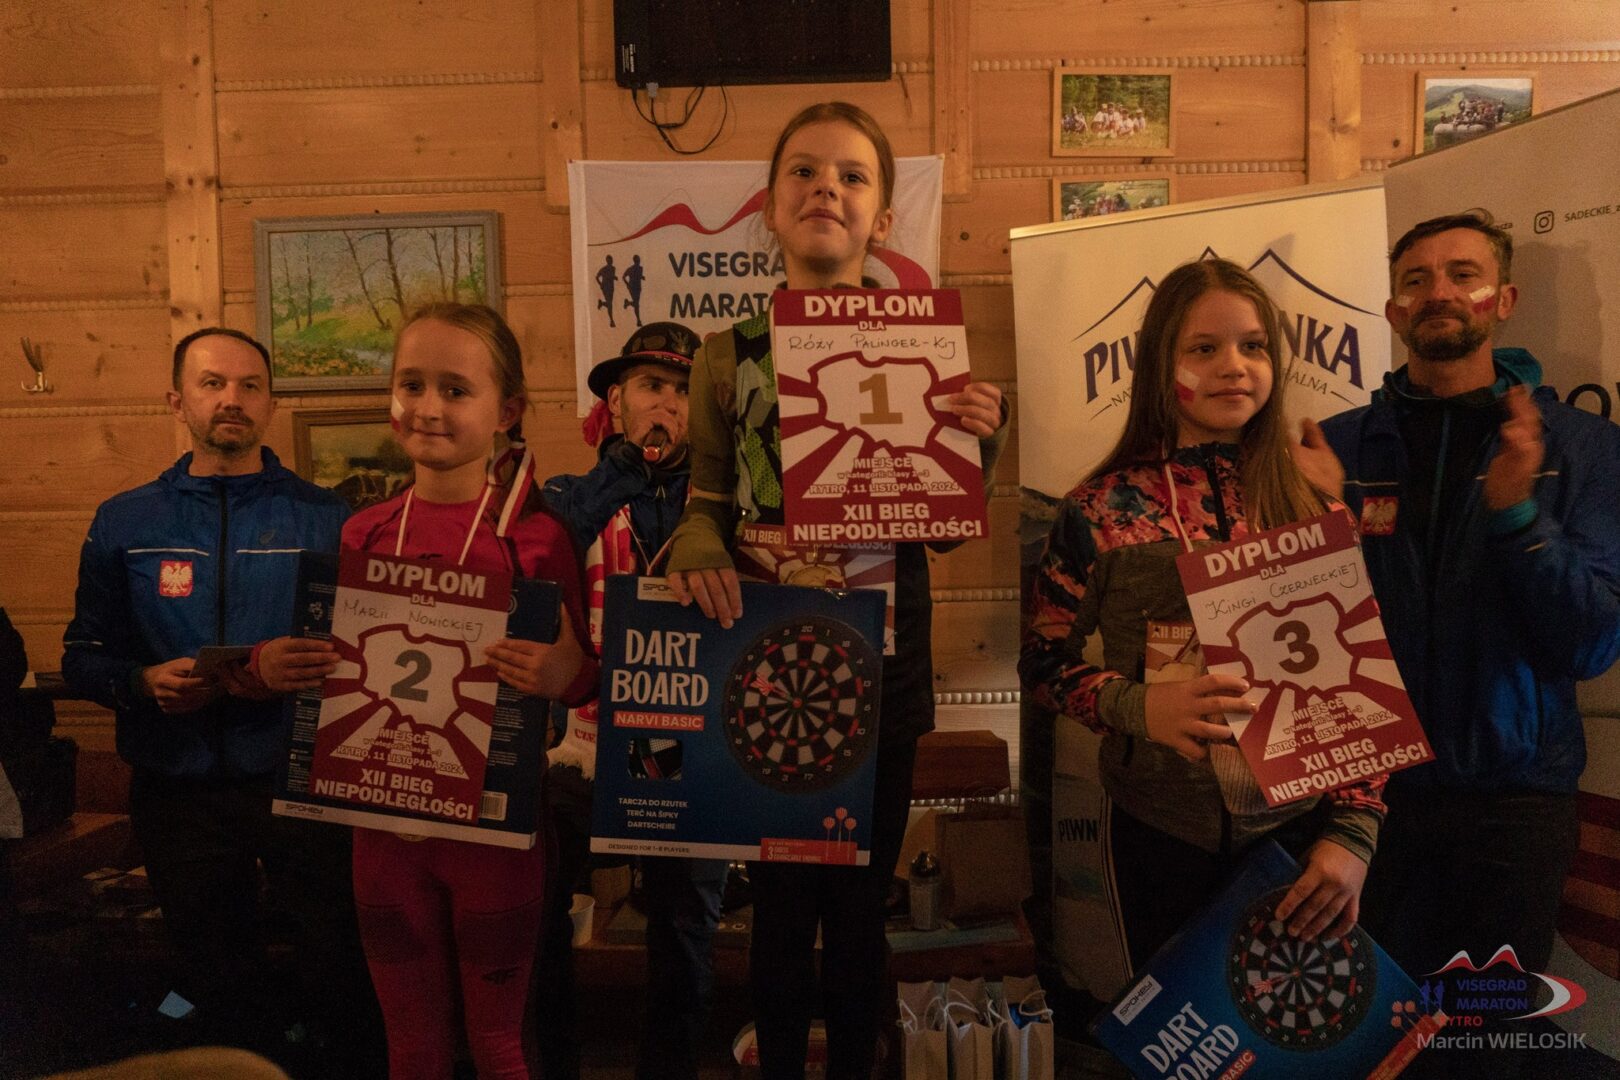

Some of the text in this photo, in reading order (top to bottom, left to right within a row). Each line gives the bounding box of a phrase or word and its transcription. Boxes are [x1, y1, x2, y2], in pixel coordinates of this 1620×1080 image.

[669, 252, 787, 278] VISEGRA
[670, 293, 774, 318] MARAT
[804, 295, 935, 317] DYPLOM
[858, 320, 886, 331] DLA
[858, 373, 903, 425] 1
[854, 457, 912, 469] MIEJSCE
[809, 481, 960, 495] RYTRO, 11 LISTOPADA 2024
[843, 503, 930, 521] XII BIEG
[758, 529, 782, 545] BIEG
[793, 516, 982, 541] NIEPODLEGŁOŚCI
[1203, 523, 1327, 578] DYPLOM
[366, 559, 486, 599] DYPLOM
[1260, 565, 1287, 580] DLA
[411, 593, 435, 607] DLA
[1172, 625, 1195, 639] BIE
[625, 628, 702, 668] DART
[1273, 620, 1320, 675] 3
[390, 649, 432, 702] 2
[610, 669, 709, 707] BOARD
[616, 713, 702, 728] NARVI BASIC
[1292, 697, 1345, 721] MIEJSCE
[379, 728, 429, 744] MIEJSCE
[1314, 717, 1367, 741] LISTOPADA
[1366, 710, 1393, 725] 2024
[1300, 738, 1378, 773] XII BIEG
[359, 768, 434, 795] XII BIEG
[1268, 741, 1429, 803] NIEPODLEGŁOŚCI
[314, 778, 474, 821] NIEPODLEGŁOŚCI
[1140, 1001, 1209, 1074] DART
[1166, 1024, 1240, 1080] OARD
